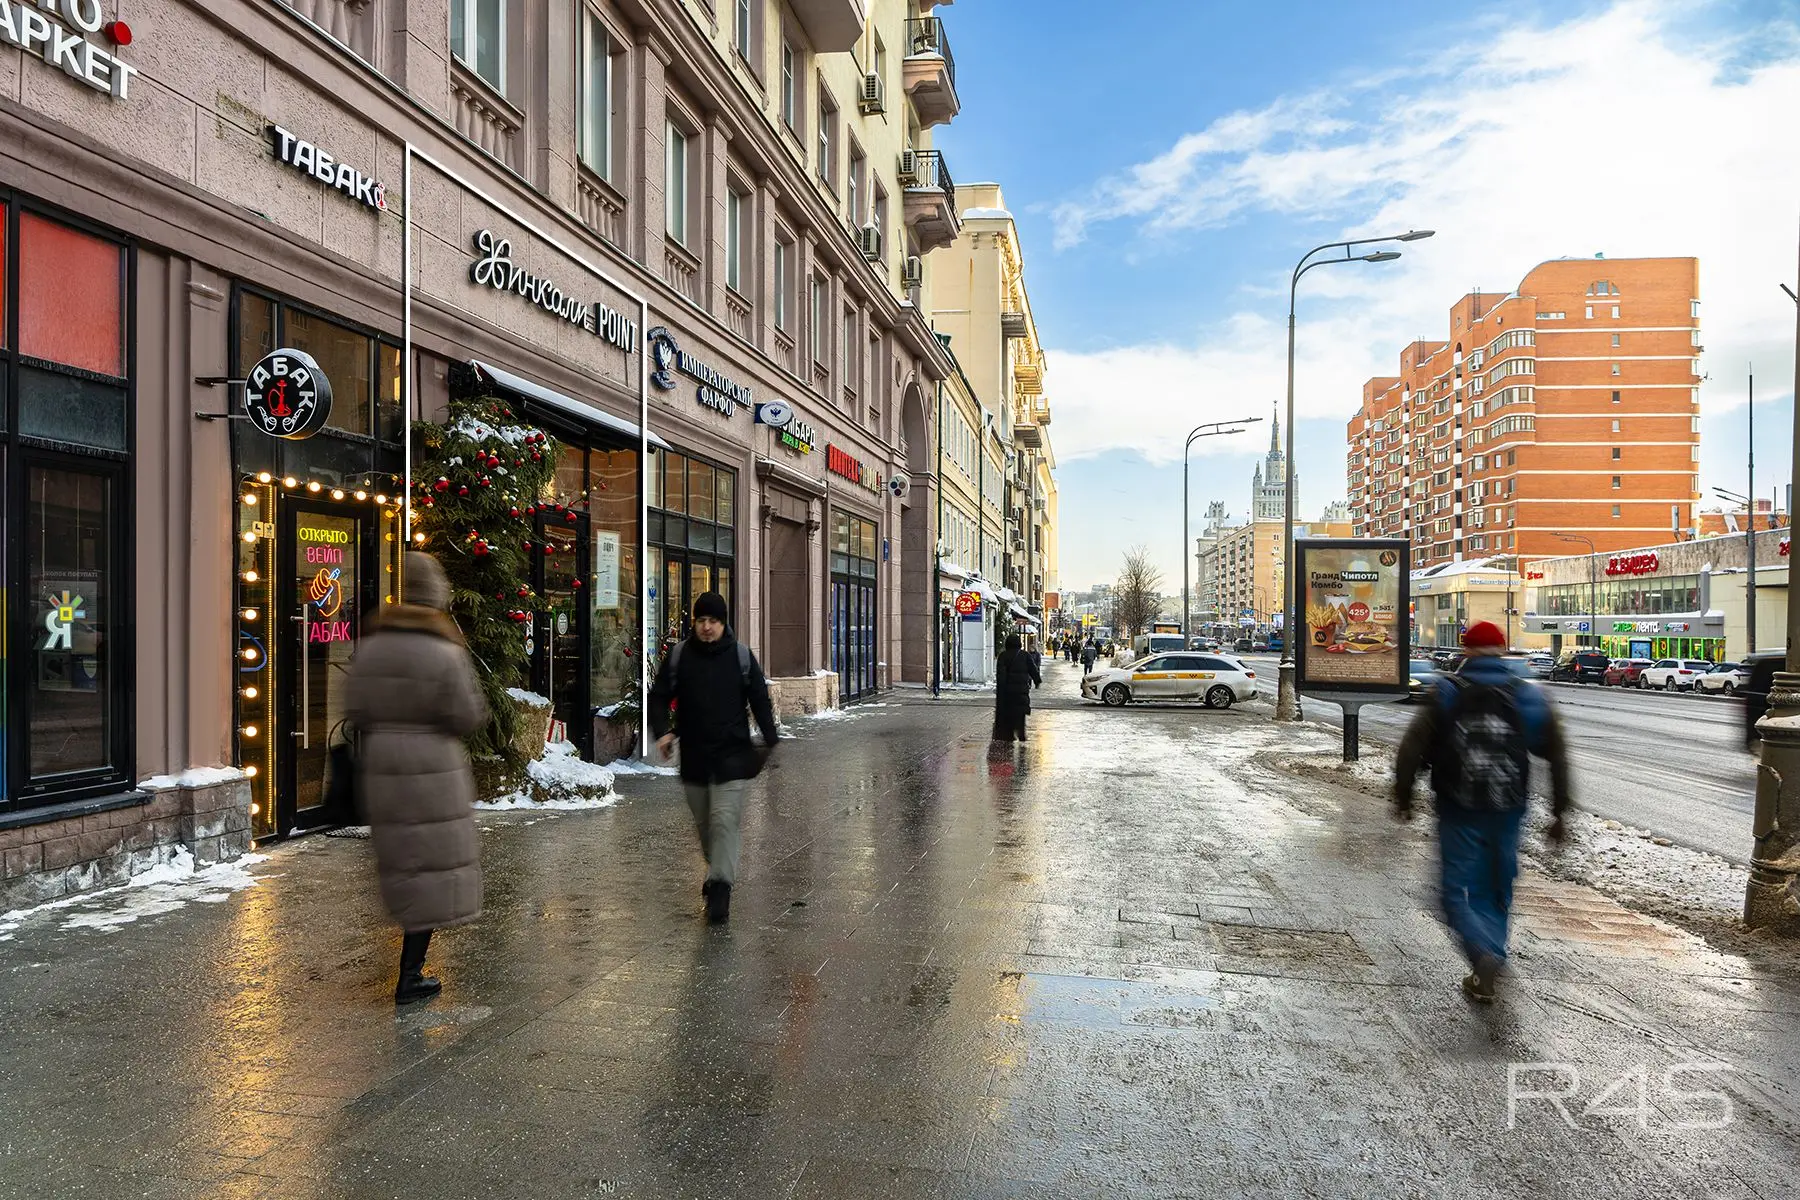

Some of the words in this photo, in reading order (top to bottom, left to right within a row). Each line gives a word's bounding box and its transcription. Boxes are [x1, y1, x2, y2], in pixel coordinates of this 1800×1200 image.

[274, 124, 375, 207] ТАБАК
[599, 302, 638, 355] POINT
[246, 356, 315, 409] ТАБАК
[680, 350, 753, 407] ИМПЕРАТОРСКИЙ
[700, 386, 737, 418] ФАРФОР
[299, 527, 349, 544] ОТКРЫТО
[306, 543, 343, 564] ВЕЙП
[1311, 571, 1340, 581] Гранд
[1341, 571, 1378, 580] Чипотл
[1311, 580, 1343, 590] Комбо
[959, 600, 972, 608] 24
